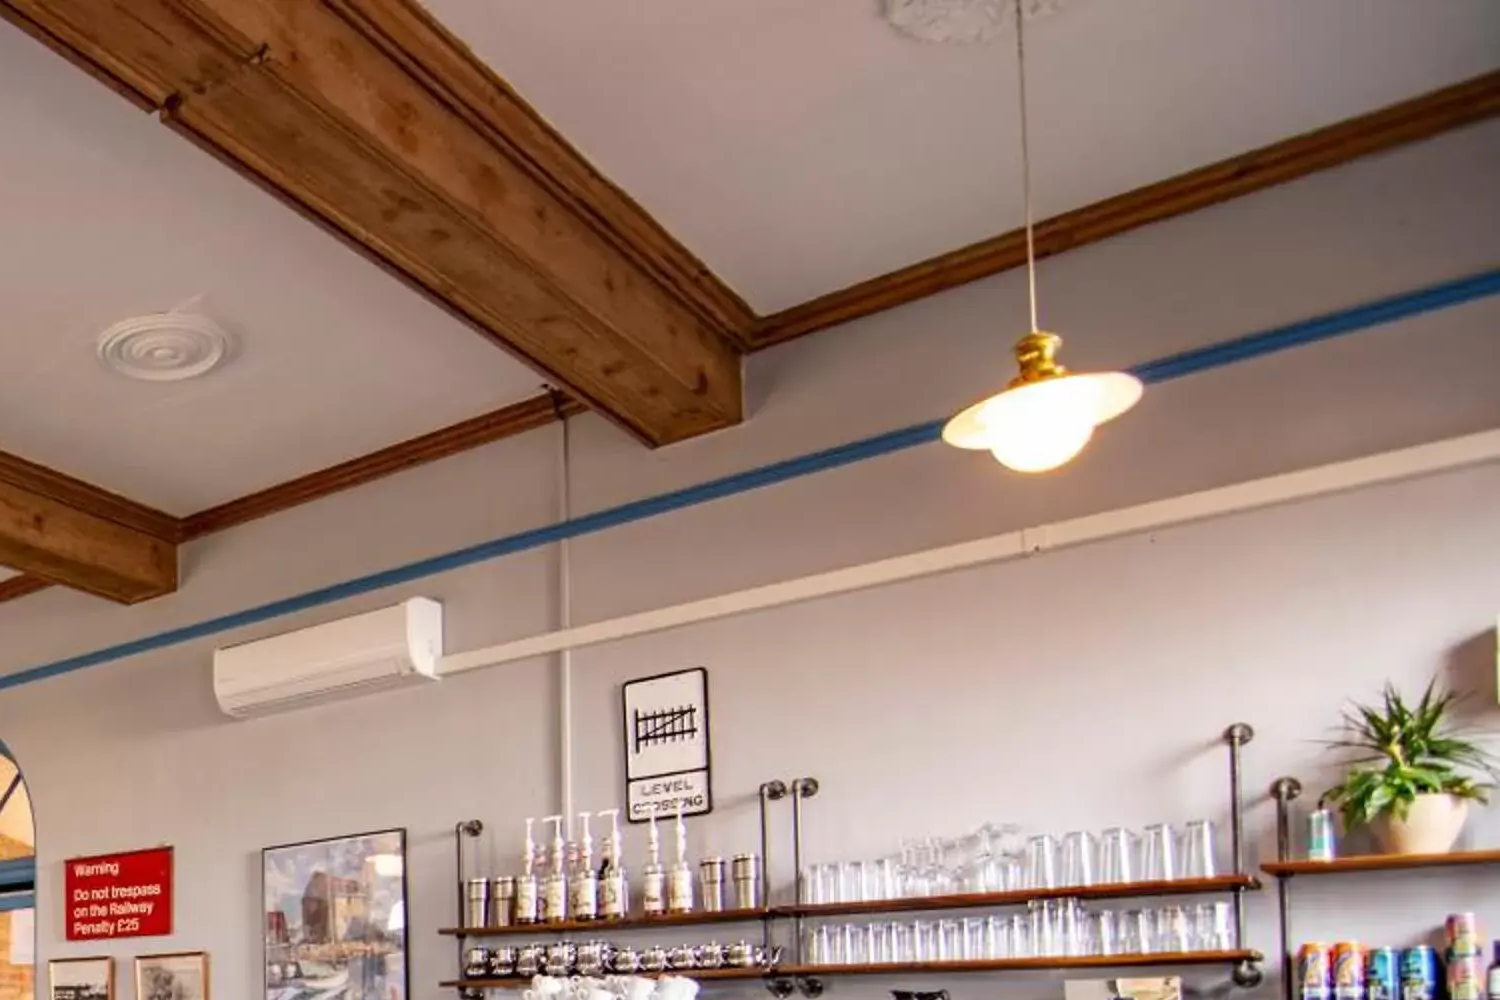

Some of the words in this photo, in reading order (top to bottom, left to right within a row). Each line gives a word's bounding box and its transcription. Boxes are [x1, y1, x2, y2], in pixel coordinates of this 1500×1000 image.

[641, 779, 694, 796] LEVEL
[74, 862, 119, 877] Warning
[74, 889, 89, 901] Do
[91, 886, 109, 899] not
[111, 884, 161, 898] trespass
[74, 907, 88, 918] on
[89, 904, 108, 917] the
[109, 902, 154, 916] Railway
[73, 920, 114, 935] Penalty
[117, 918, 139, 932] £25
